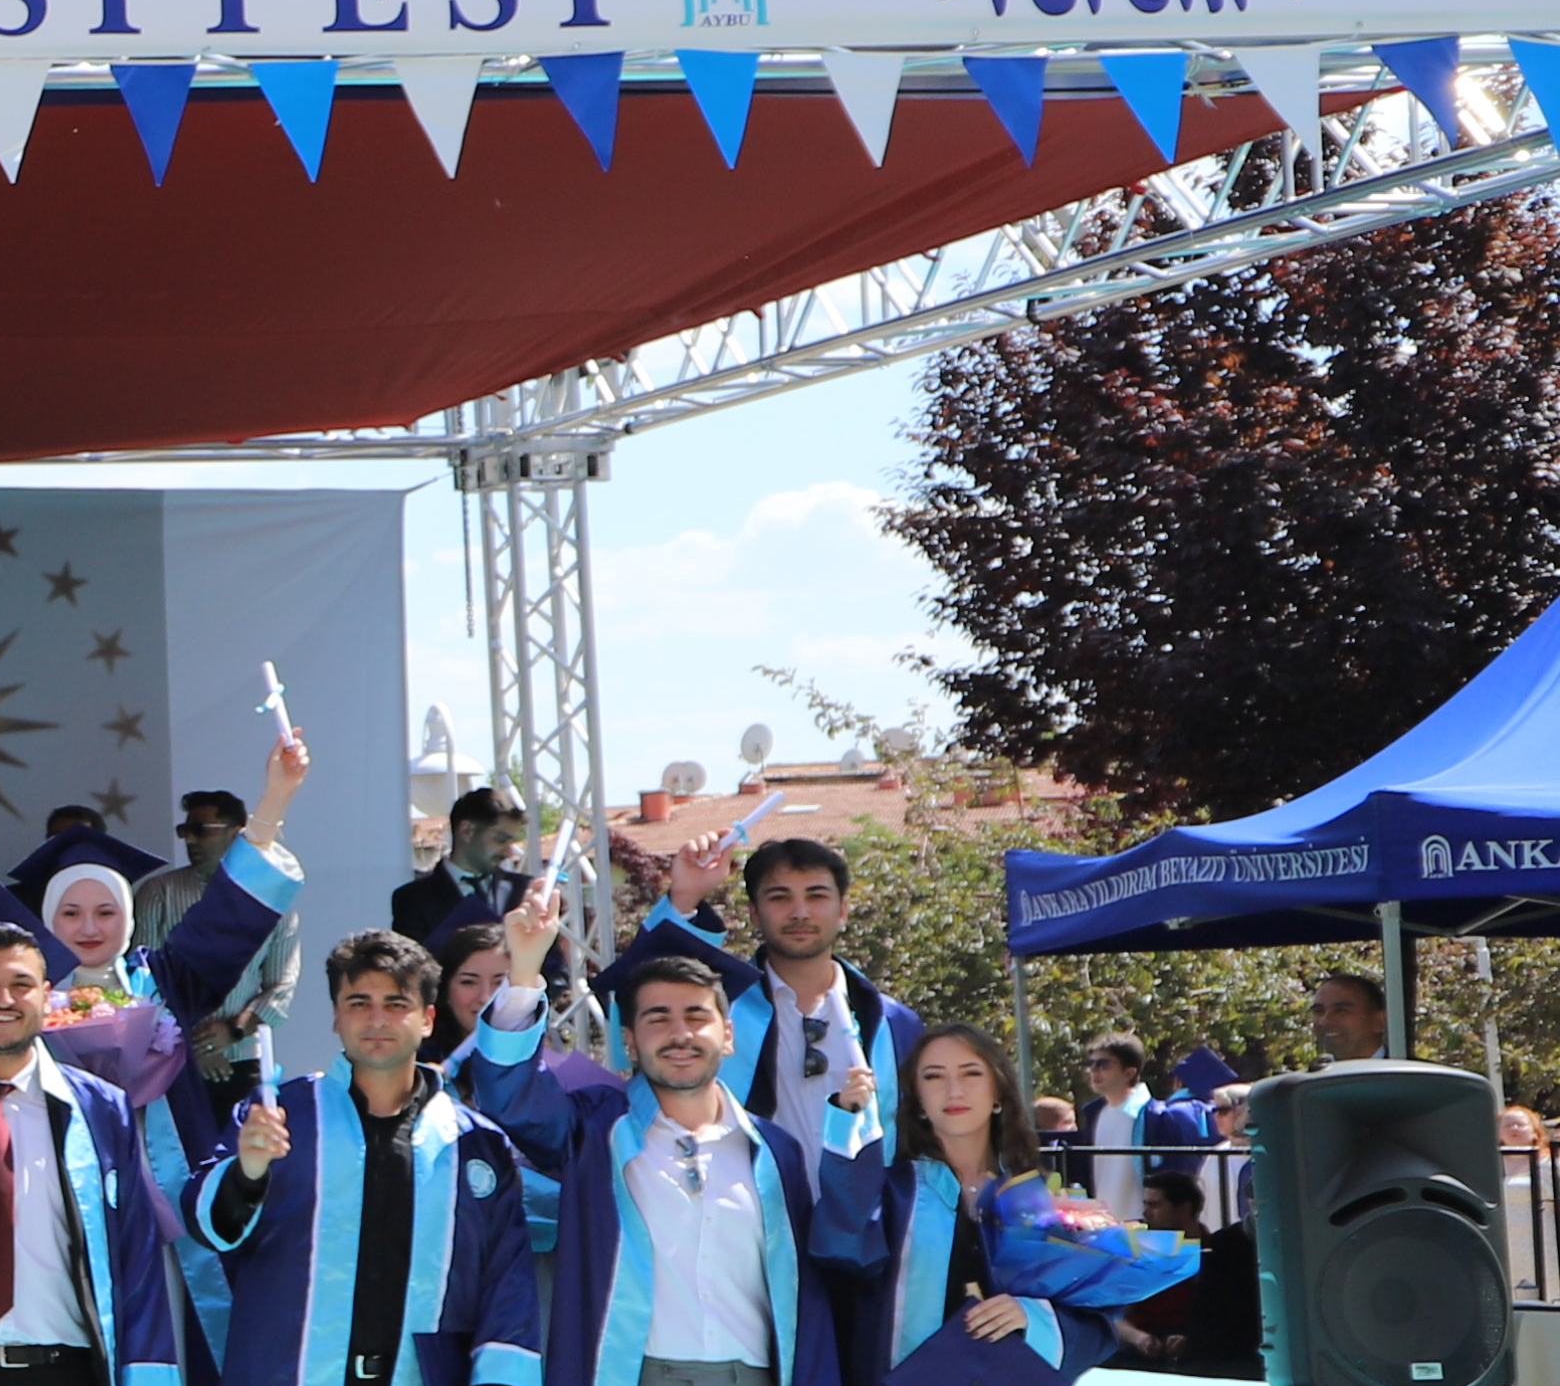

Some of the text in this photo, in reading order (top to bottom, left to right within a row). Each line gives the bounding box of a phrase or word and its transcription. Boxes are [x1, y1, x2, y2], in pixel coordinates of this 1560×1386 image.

[1032, 836, 1368, 921] ANKARA YILDIRIM BEYAZIT ÜNİVERSİTESİ
[1455, 839, 1560, 871] ANK
